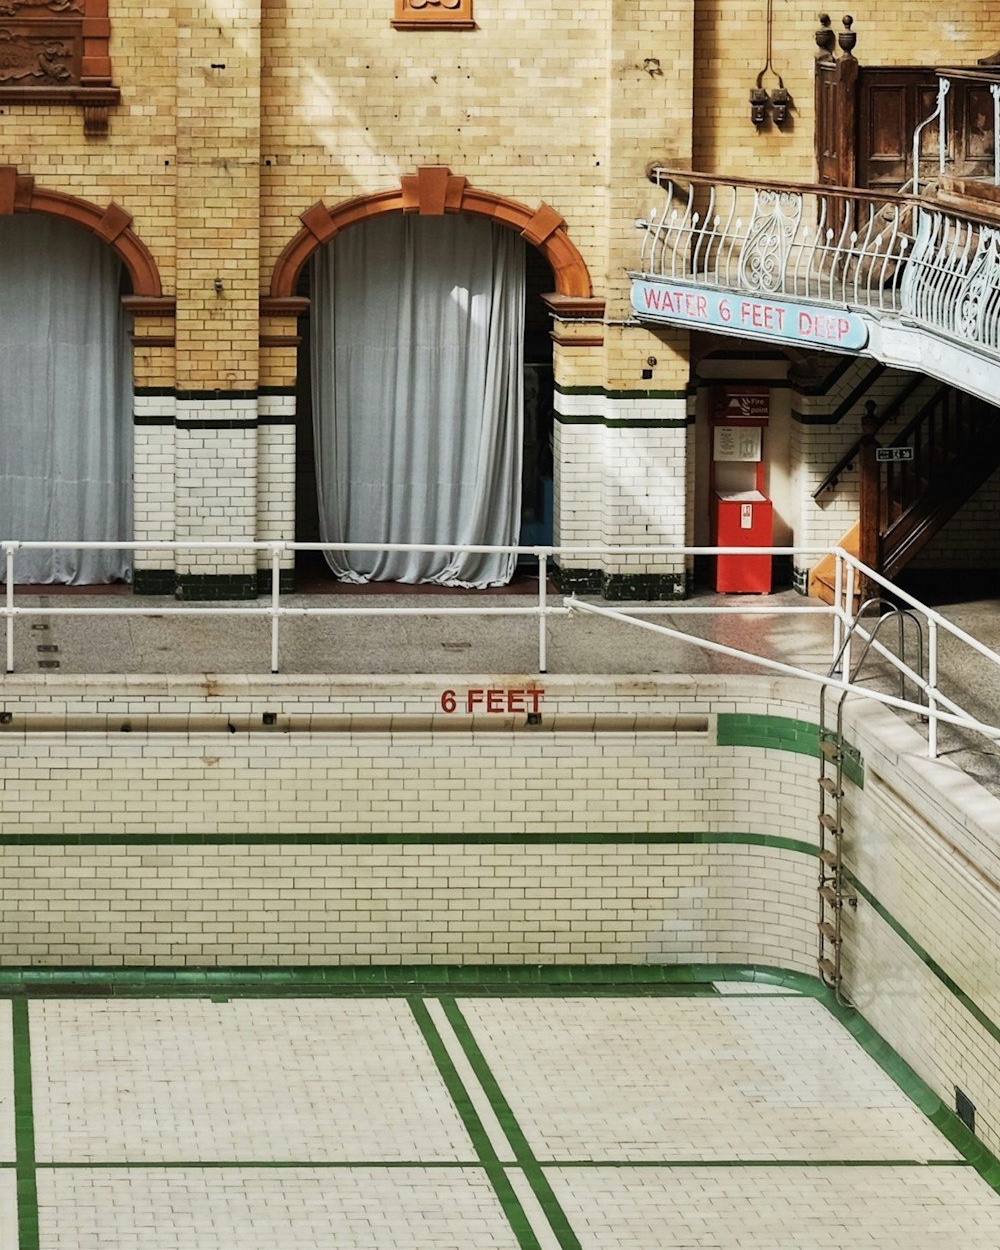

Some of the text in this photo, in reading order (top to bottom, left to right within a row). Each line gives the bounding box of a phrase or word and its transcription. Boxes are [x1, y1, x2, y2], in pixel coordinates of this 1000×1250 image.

[643, 287, 850, 342] WATER 6 FEET DEEP
[440, 689, 546, 714] 6 FEET
